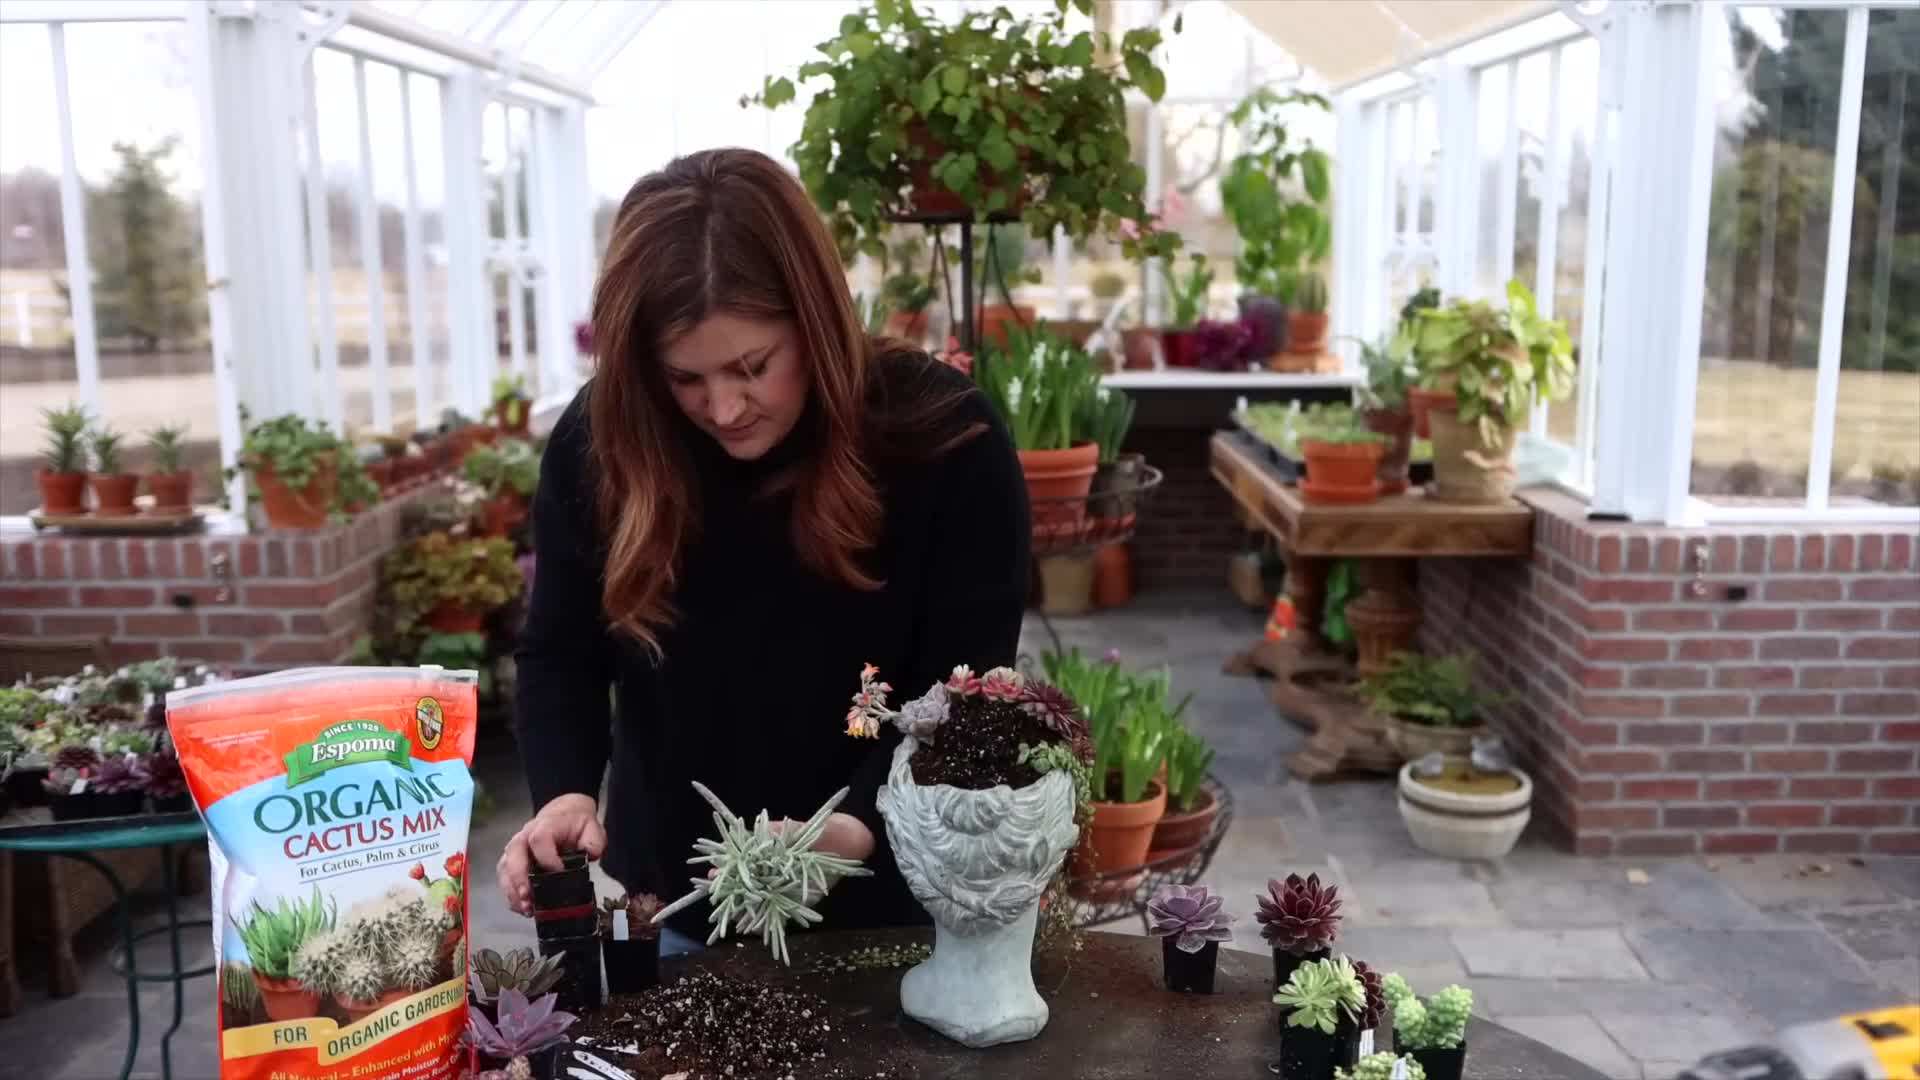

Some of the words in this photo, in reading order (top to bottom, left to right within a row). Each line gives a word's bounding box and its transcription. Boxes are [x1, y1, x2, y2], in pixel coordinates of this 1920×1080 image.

[311, 738, 396, 763] Espoma
[324, 723, 354, 738] SINCE
[253, 772, 456, 834] ORGANIC
[283, 816, 394, 860] CACTUS
[402, 805, 447, 837] MIX
[300, 866, 318, 879] For
[322, 857, 363, 873] Cactus,
[366, 848, 394, 864] Palm
[395, 847, 406, 858] &
[409, 839, 440, 856] Citrus
[273, 1026, 308, 1045] FOR
[327, 1010, 400, 1057] ORGANIC
[351, 1050, 412, 1077] Enhanced
[413, 1040, 436, 1057] with
